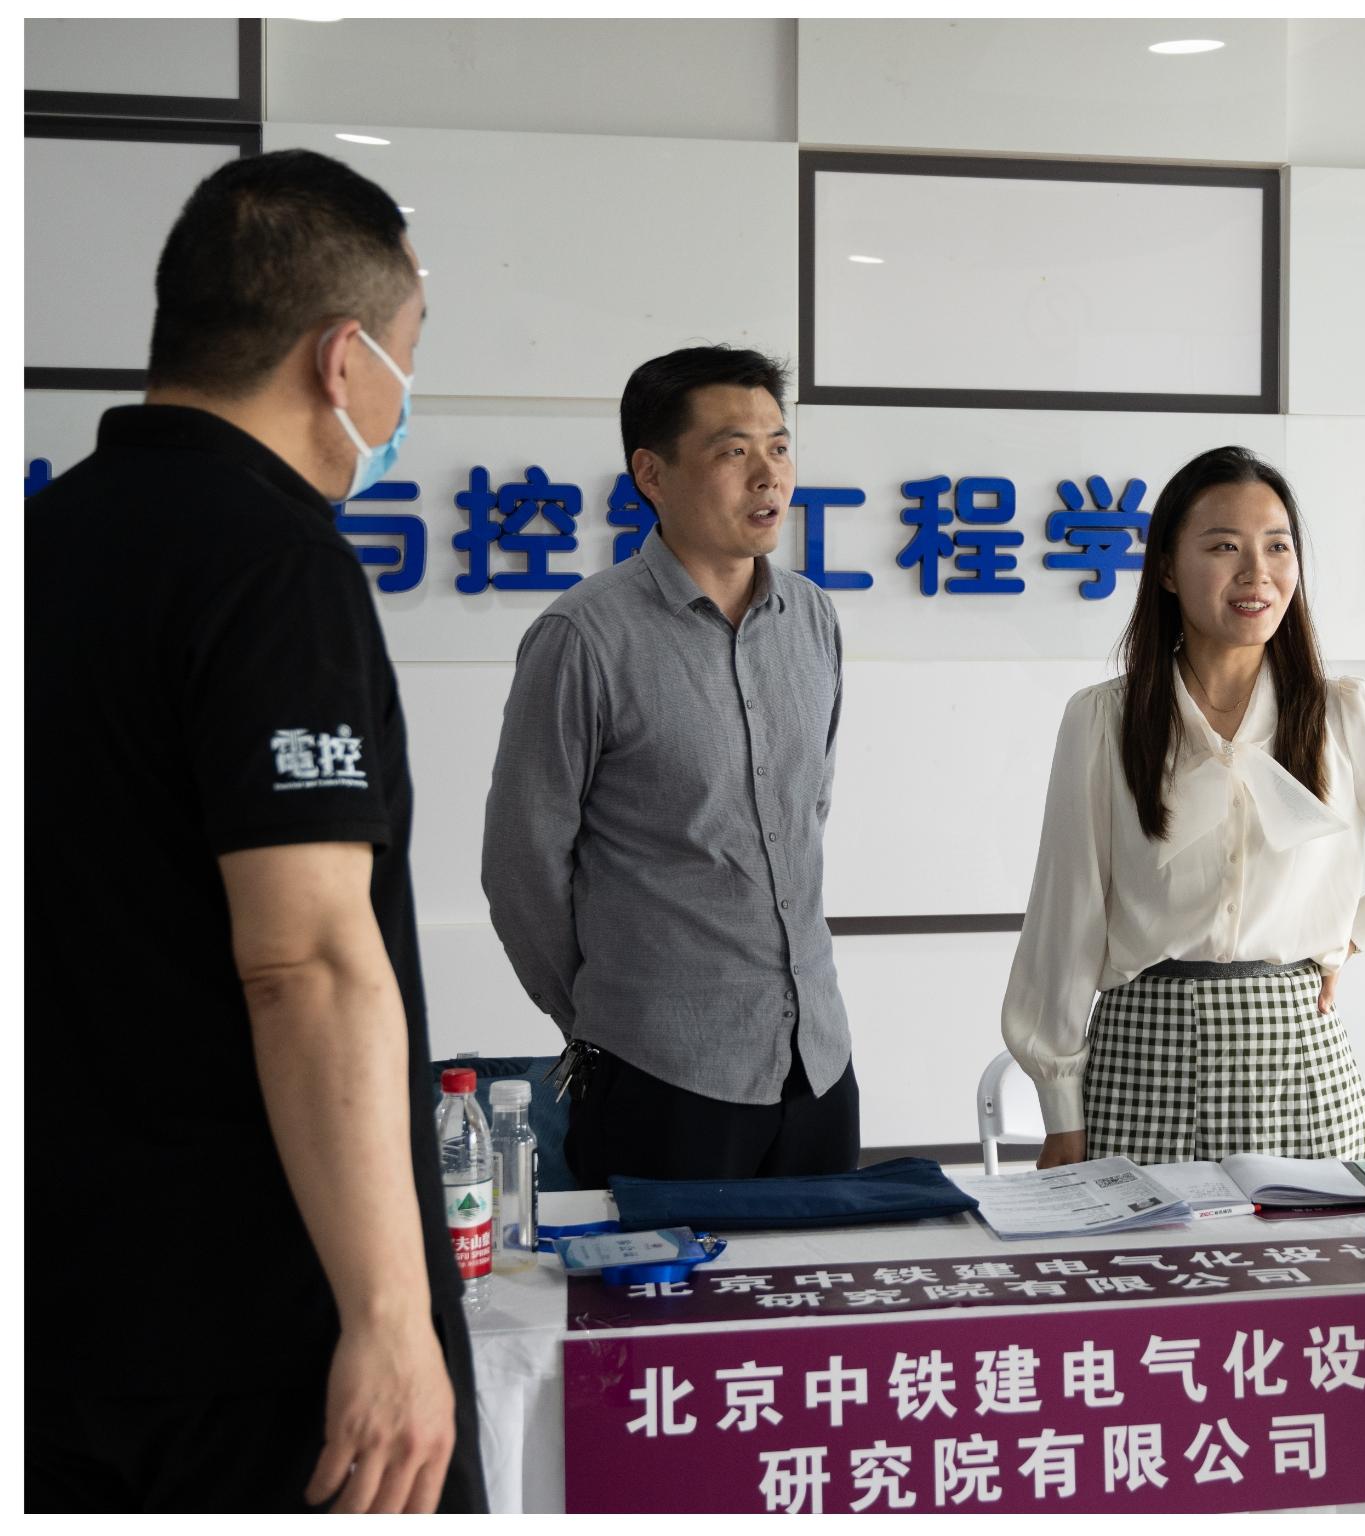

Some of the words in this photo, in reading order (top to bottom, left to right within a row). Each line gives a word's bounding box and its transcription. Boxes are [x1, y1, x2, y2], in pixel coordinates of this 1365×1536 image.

[754, 1265, 1311, 1310] 研究院有限公司
[759, 1413, 1330, 1514] 研究院有限公司
